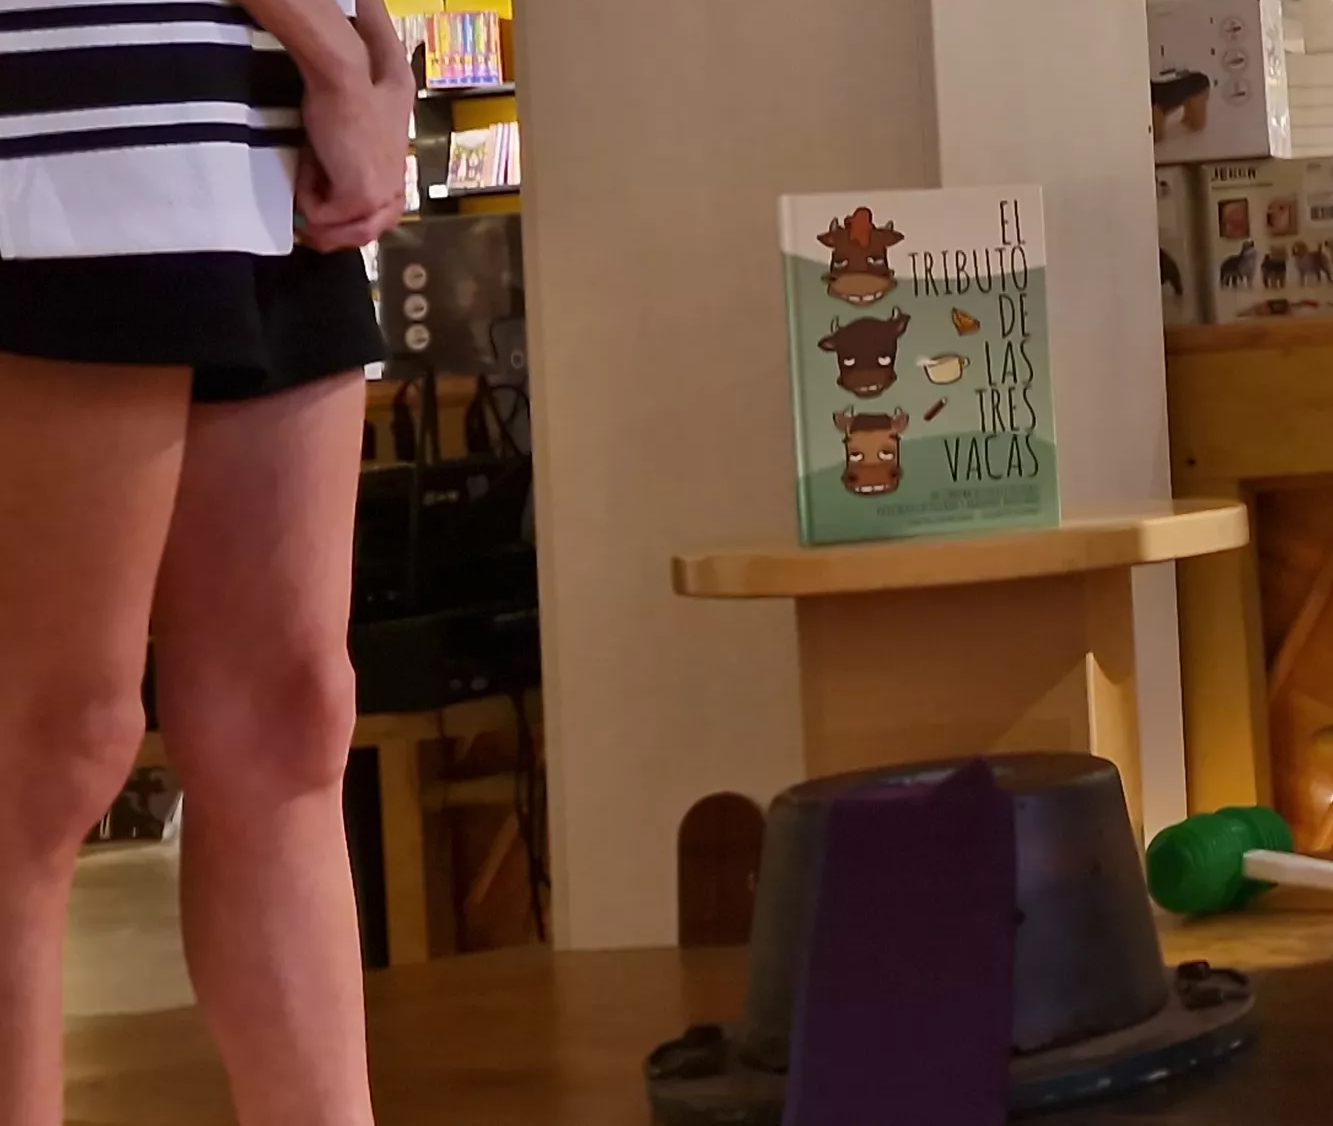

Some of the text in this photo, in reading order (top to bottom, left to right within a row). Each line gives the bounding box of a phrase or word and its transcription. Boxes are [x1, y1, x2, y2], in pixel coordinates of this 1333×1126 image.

[1000, 199, 1026, 247] EL
[908, 245, 1029, 297] TRIBUTO
[998, 292, 1030, 339] DE
[984, 339, 1035, 387] LAS
[975, 385, 1038, 434] TRES
[943, 433, 1040, 482] VACAS
